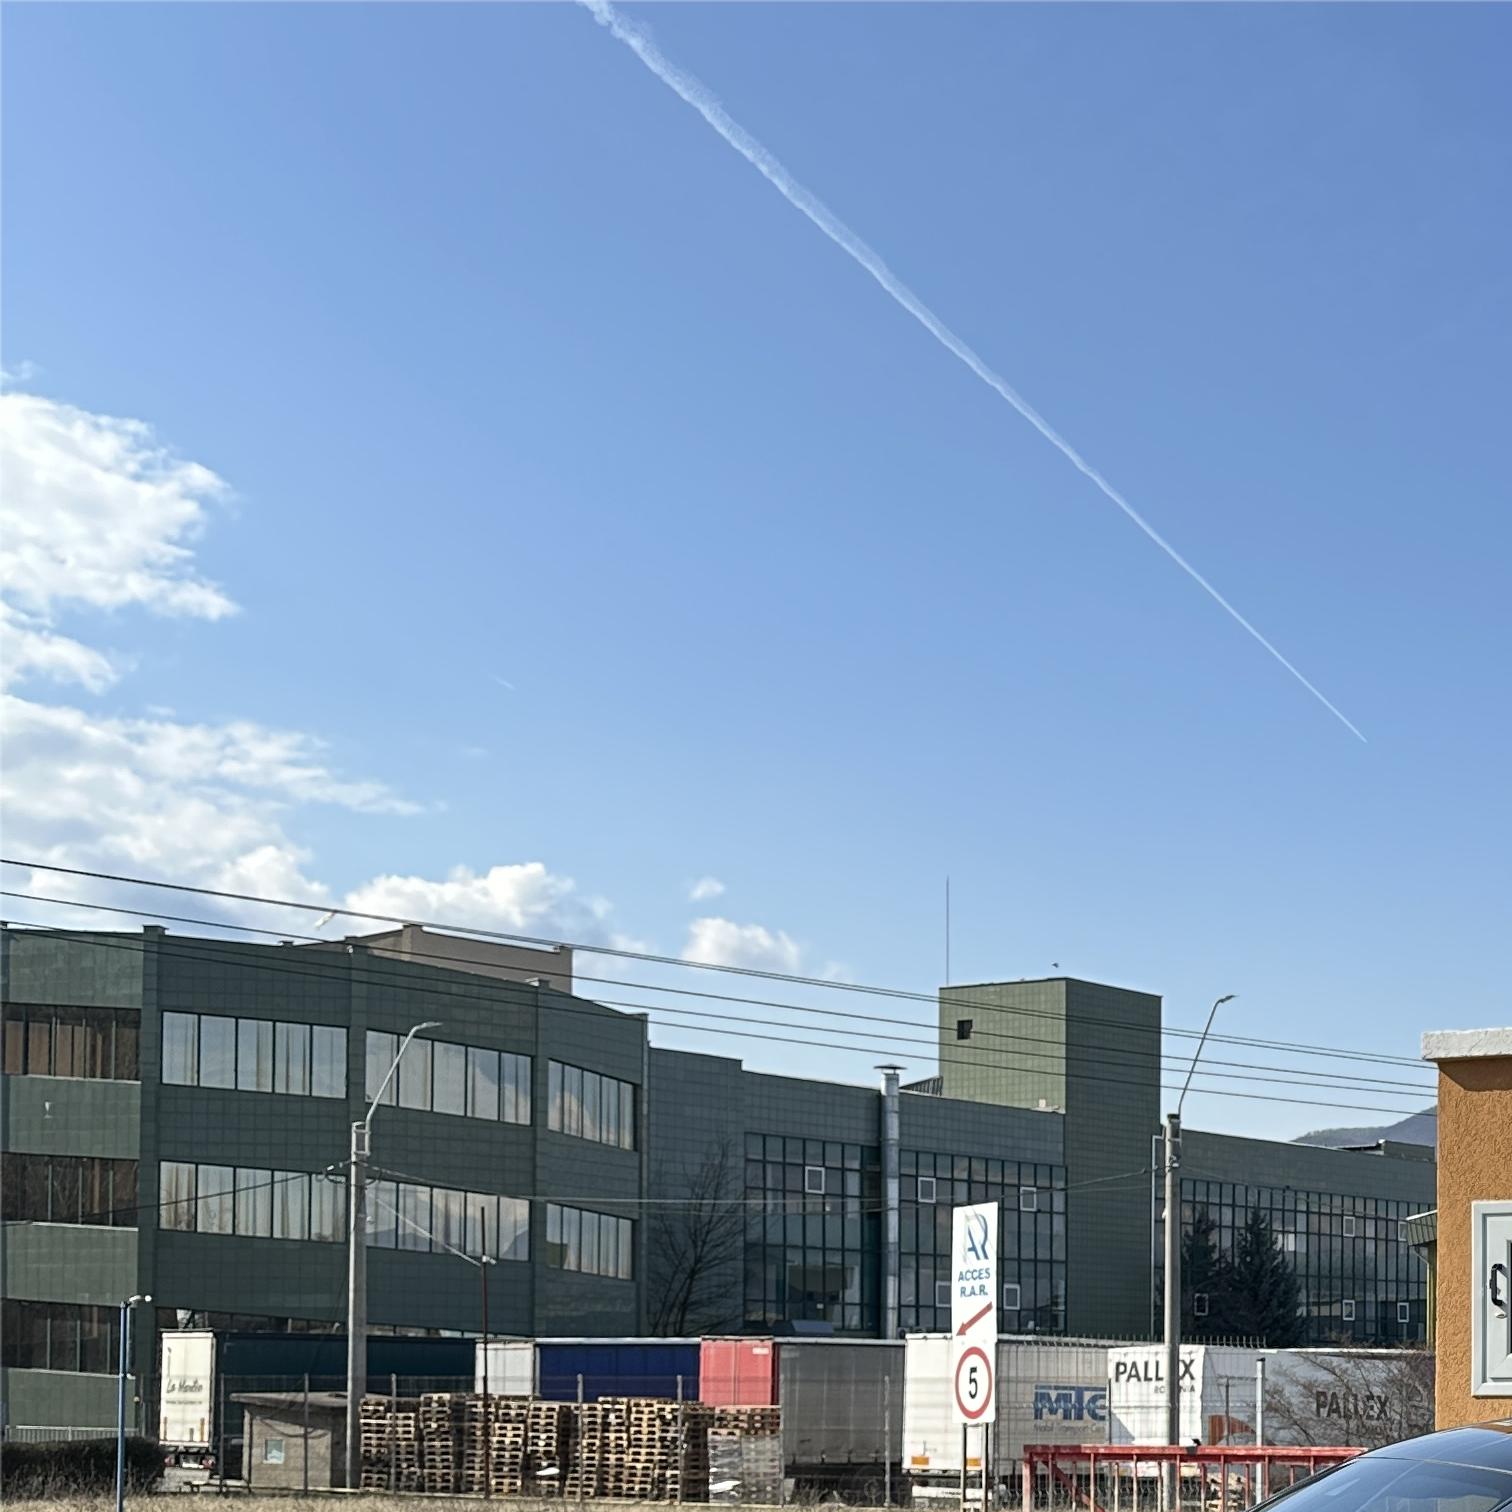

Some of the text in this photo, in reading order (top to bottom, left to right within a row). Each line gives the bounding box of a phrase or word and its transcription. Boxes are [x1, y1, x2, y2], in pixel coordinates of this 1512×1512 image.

[957, 1268, 991, 1282] ACCES
[959, 1284, 989, 1298] R.A.R.
[1115, 1359, 1196, 1383] PALLX
[968, 1366, 979, 1400] 5
